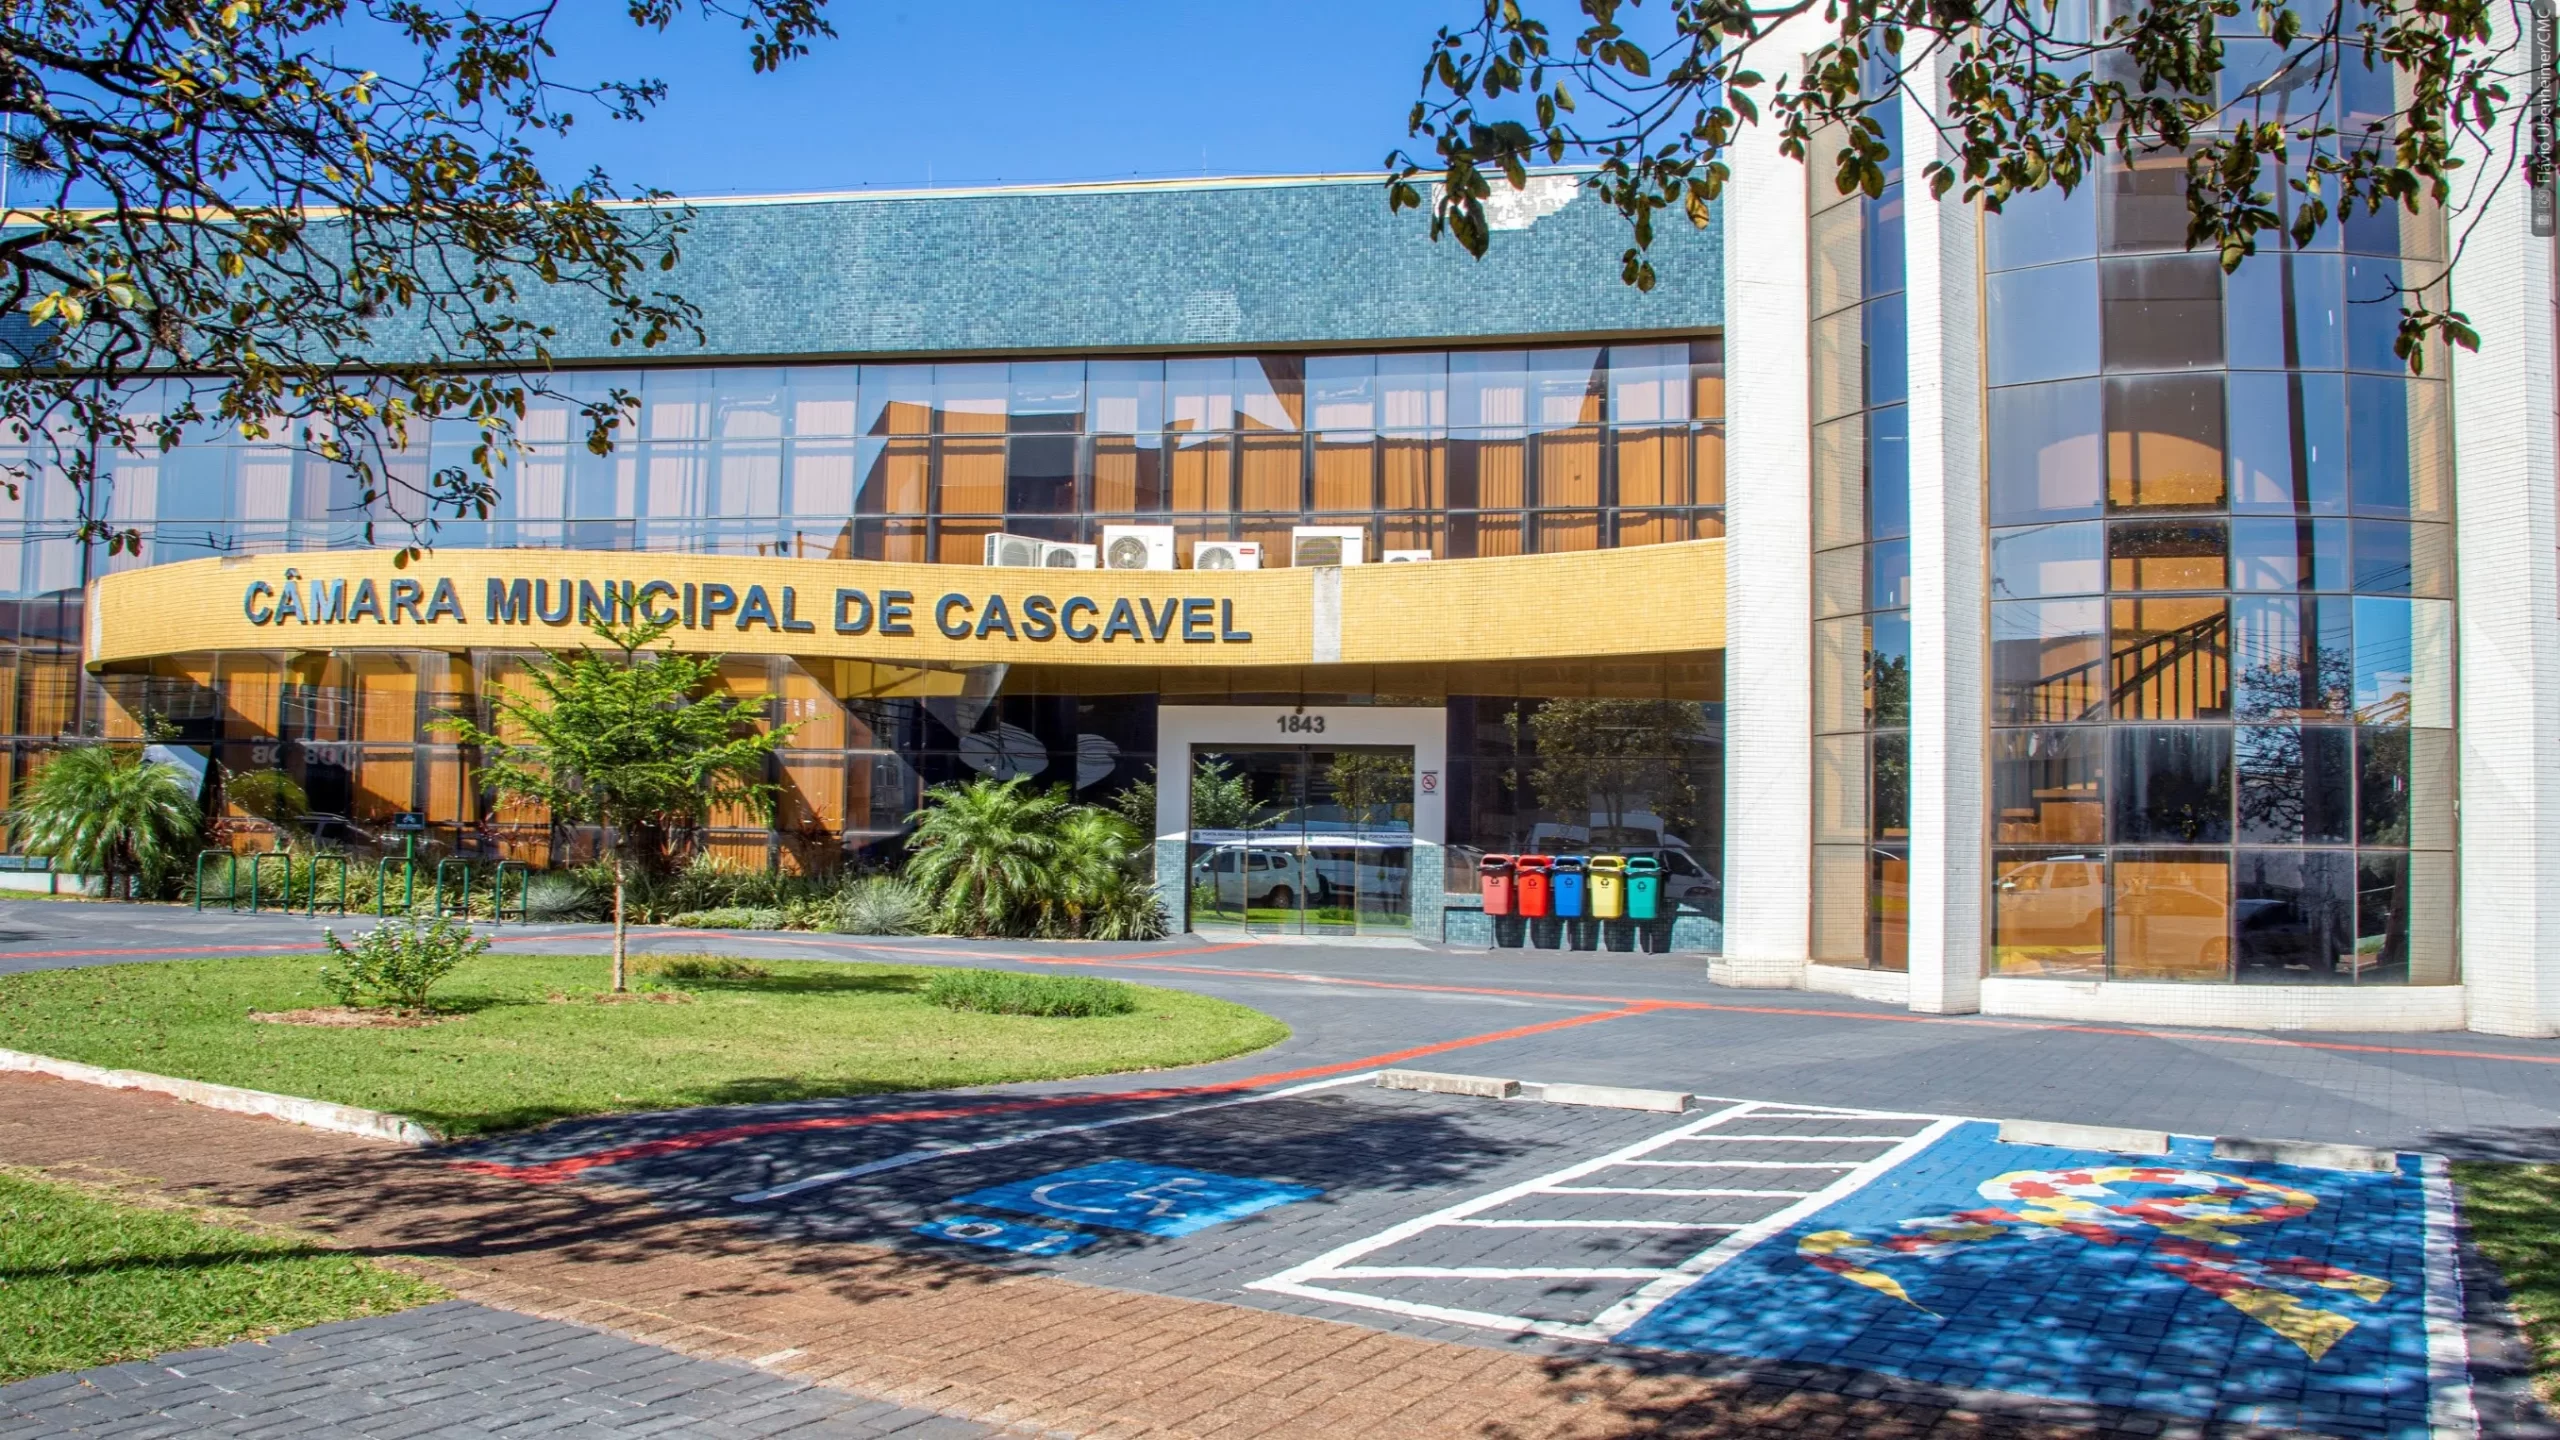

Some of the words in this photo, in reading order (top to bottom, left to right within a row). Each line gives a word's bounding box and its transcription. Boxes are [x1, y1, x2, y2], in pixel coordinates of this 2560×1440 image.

[244, 568, 466, 626] CÂMARA
[486, 577, 815, 632] MUNICIPAL
[834, 588, 914, 636] DE
[934, 592, 1252, 643] CASCAVEL
[1276, 715, 1325, 734] 1843
